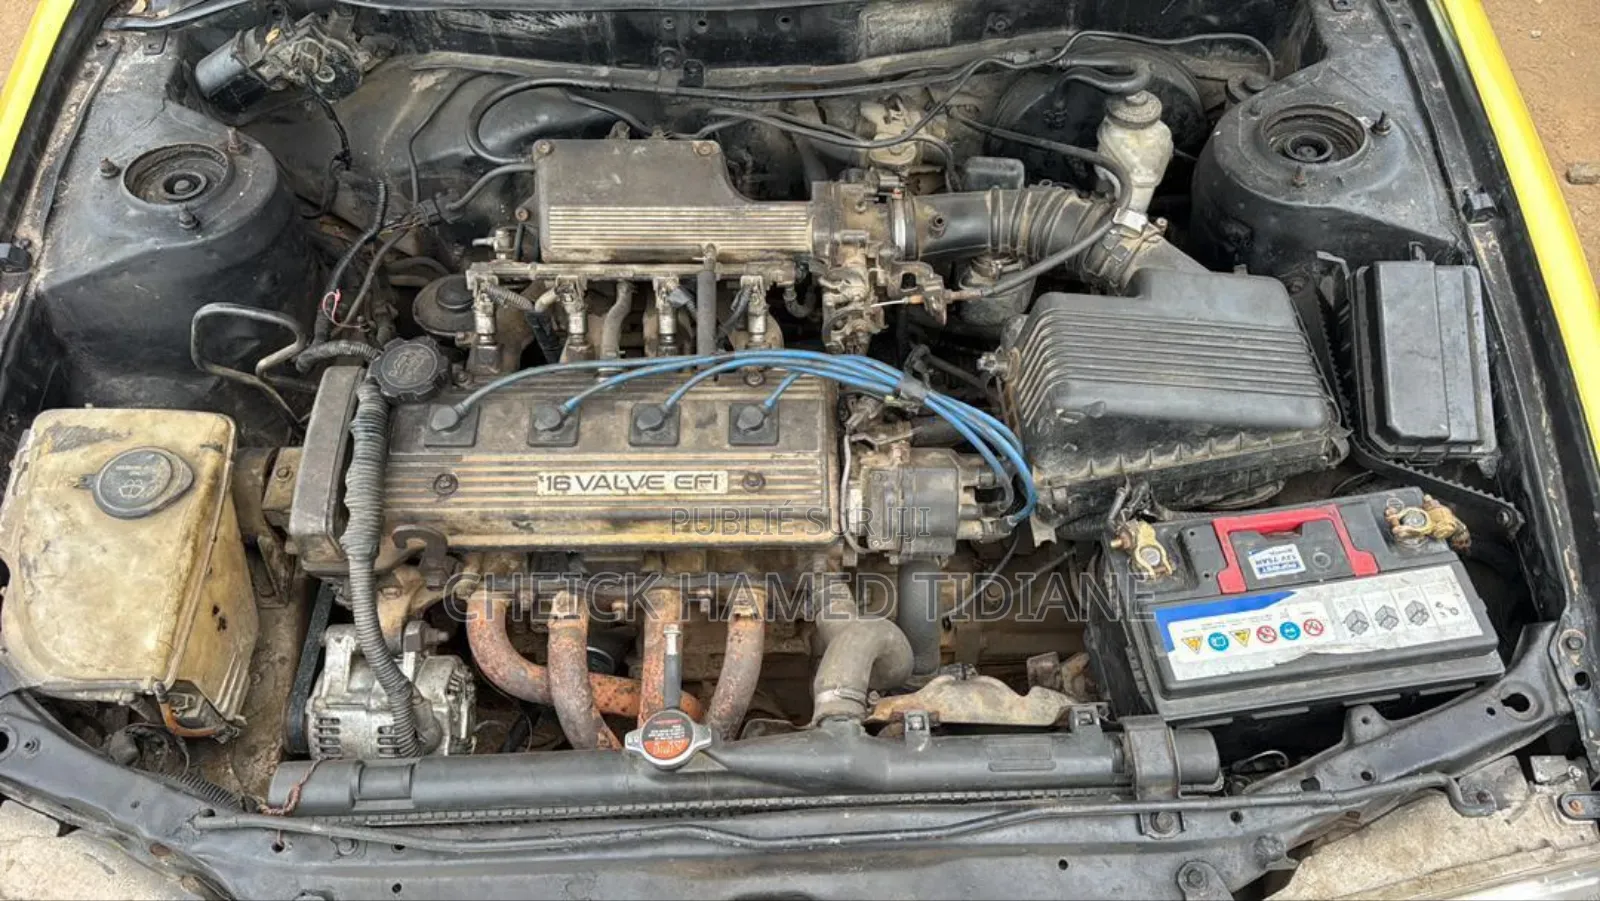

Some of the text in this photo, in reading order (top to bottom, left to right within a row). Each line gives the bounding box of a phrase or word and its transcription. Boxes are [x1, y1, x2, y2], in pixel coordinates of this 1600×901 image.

[546, 473, 718, 492] 16 VALVE EFI
